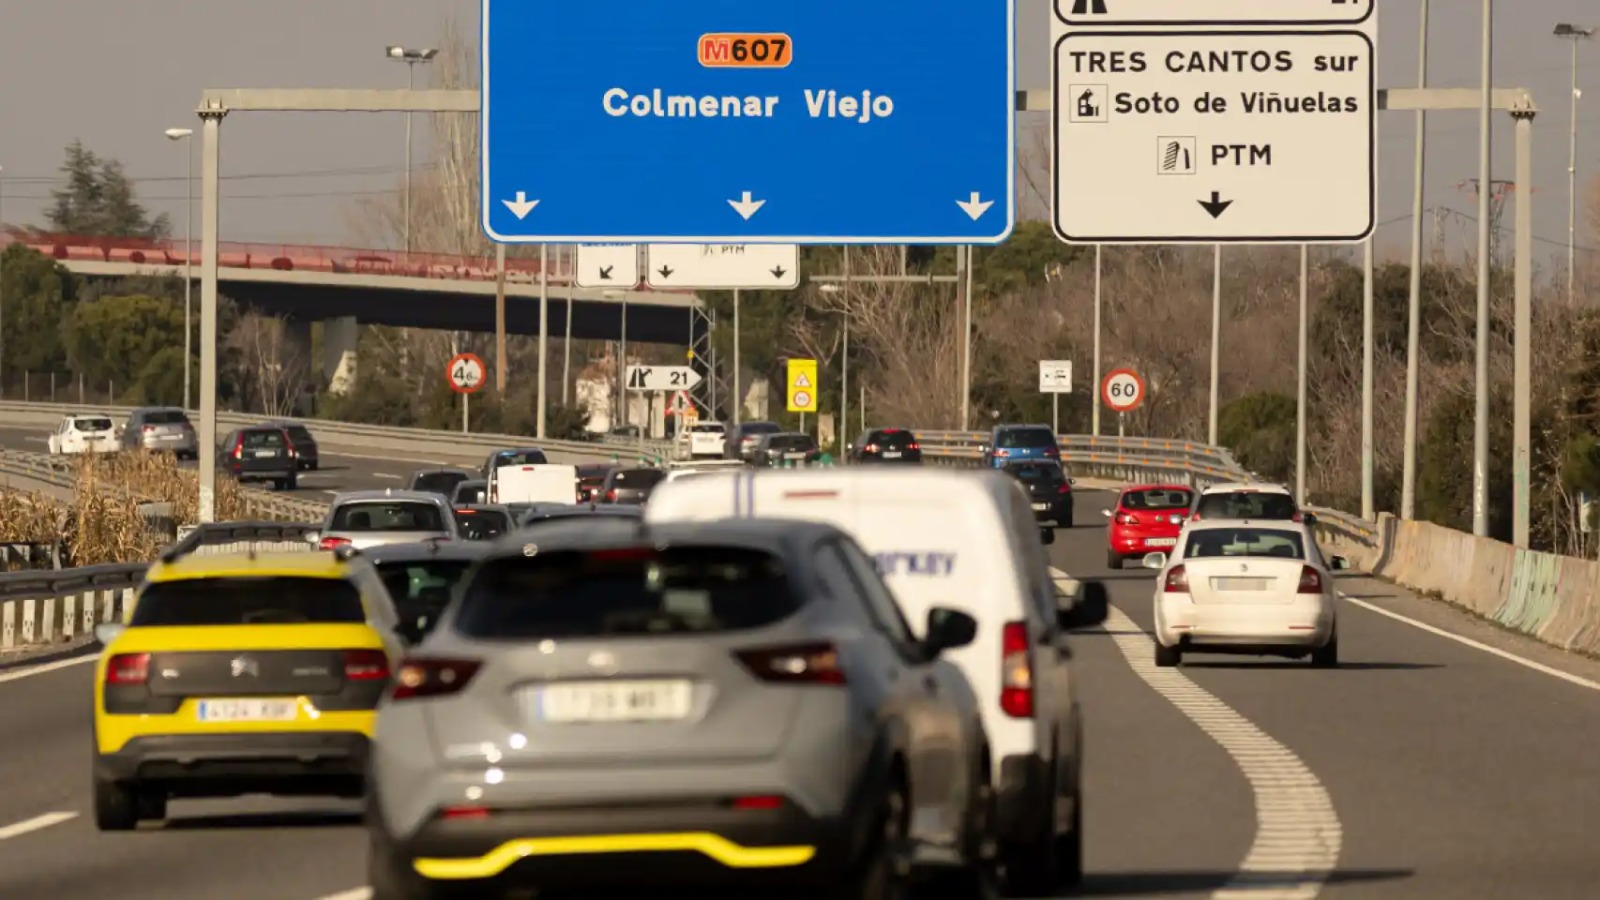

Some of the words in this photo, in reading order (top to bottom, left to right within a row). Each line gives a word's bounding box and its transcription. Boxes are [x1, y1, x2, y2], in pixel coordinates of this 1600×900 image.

[1069, 51, 1148, 73] TRES
[1165, 51, 1293, 73] CANTOS
[1314, 54, 1359, 72] sur
[602, 87, 779, 118] Colmenar
[804, 89, 894, 123] Viejo
[1114, 92, 1180, 114] Soto
[1194, 92, 1227, 114] de
[1241, 92, 1358, 114] Viñuelas
[1211, 144, 1272, 166] PTM
[670, 371, 688, 385] 21
[1111, 383, 1135, 397] 60
